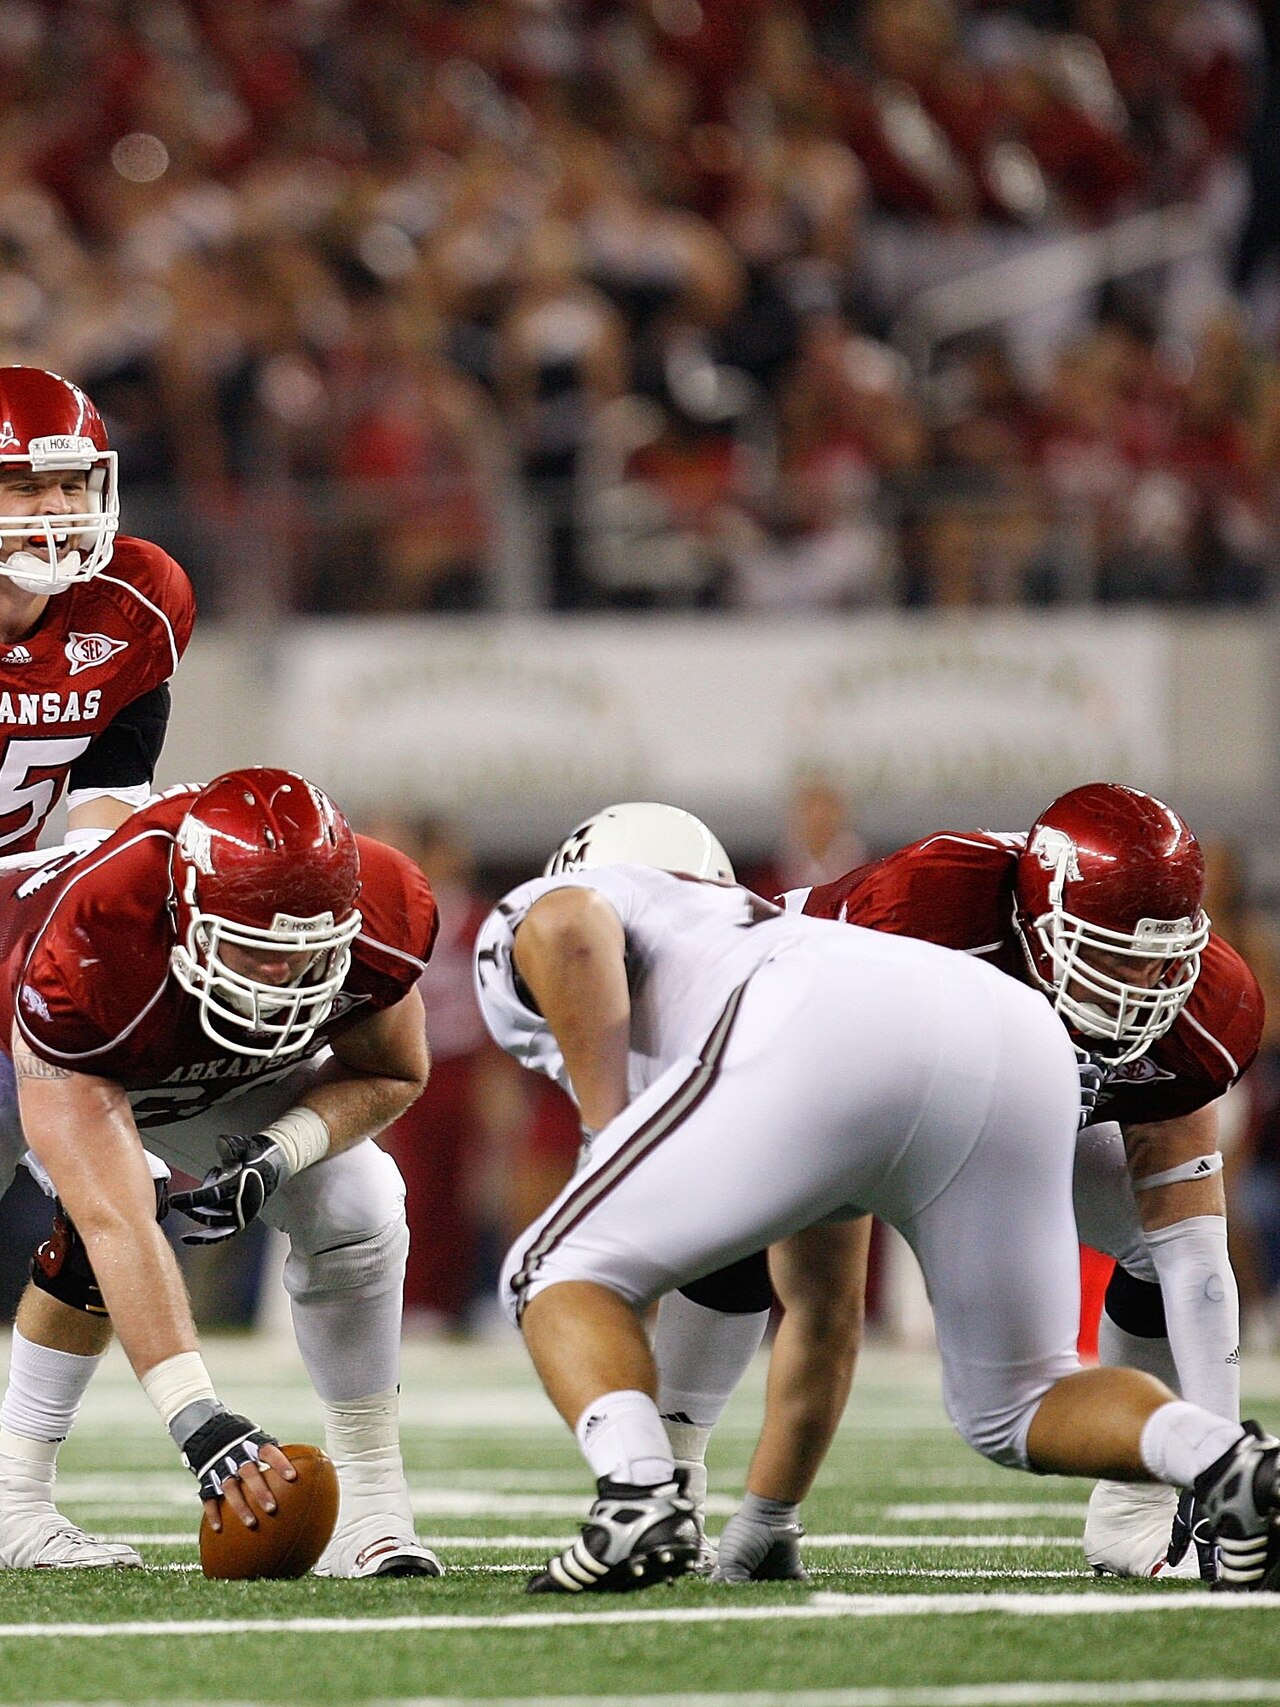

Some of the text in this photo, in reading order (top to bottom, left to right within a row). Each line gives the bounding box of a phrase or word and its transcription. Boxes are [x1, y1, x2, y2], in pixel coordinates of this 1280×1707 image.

[80, 639, 103, 661] SEC
[1, 656, 33, 664] adidas
[292, 921, 317, 931] HOGS
[1154, 923, 1177, 934] HOGS
